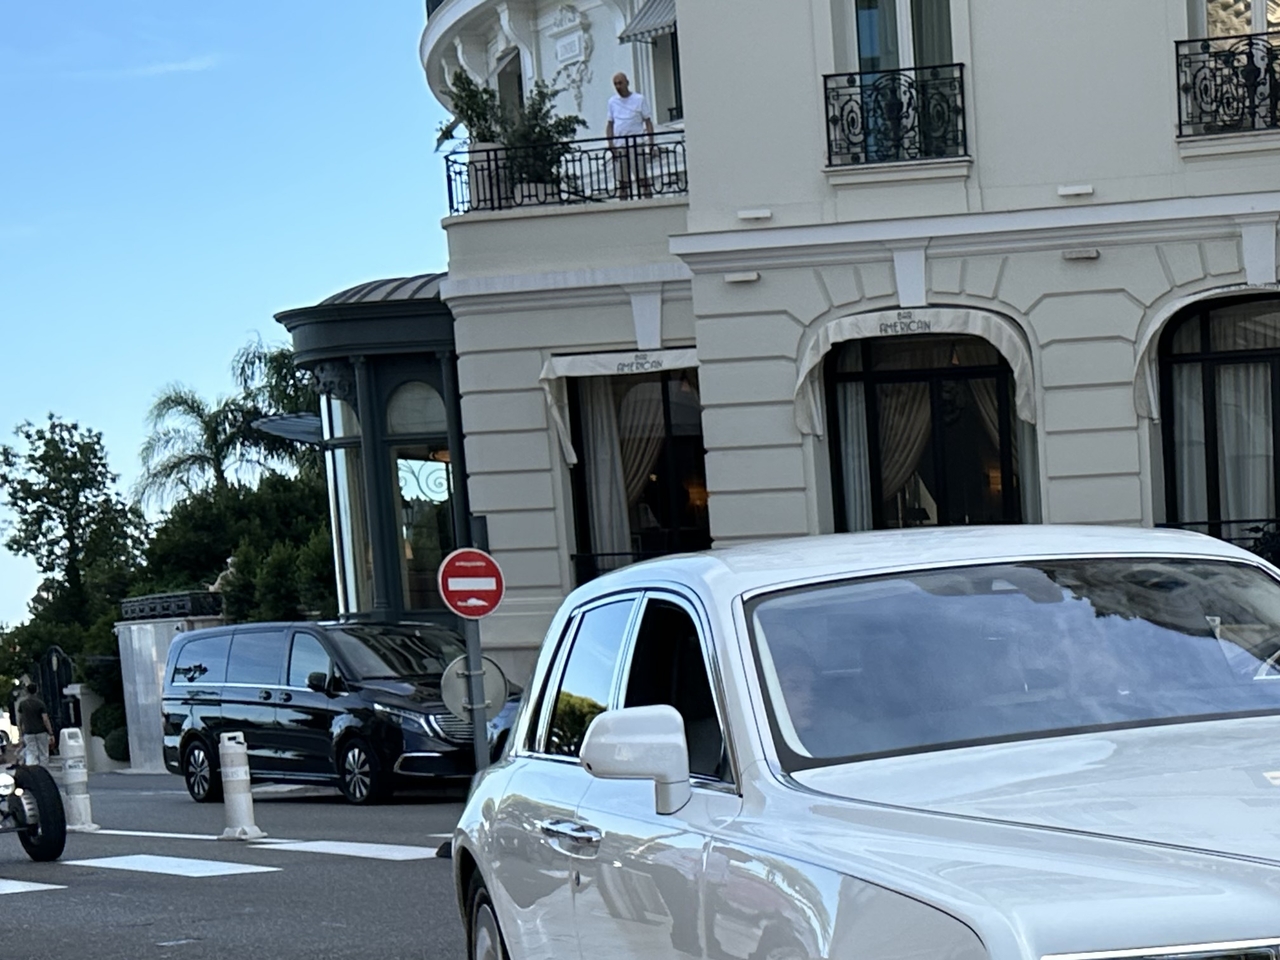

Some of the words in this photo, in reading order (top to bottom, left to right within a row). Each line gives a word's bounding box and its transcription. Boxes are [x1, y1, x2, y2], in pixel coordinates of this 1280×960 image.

[897, 311, 913, 320] BAR
[879, 320, 931, 334] AMERICAN
[616, 360, 664, 372] AMERICAN
